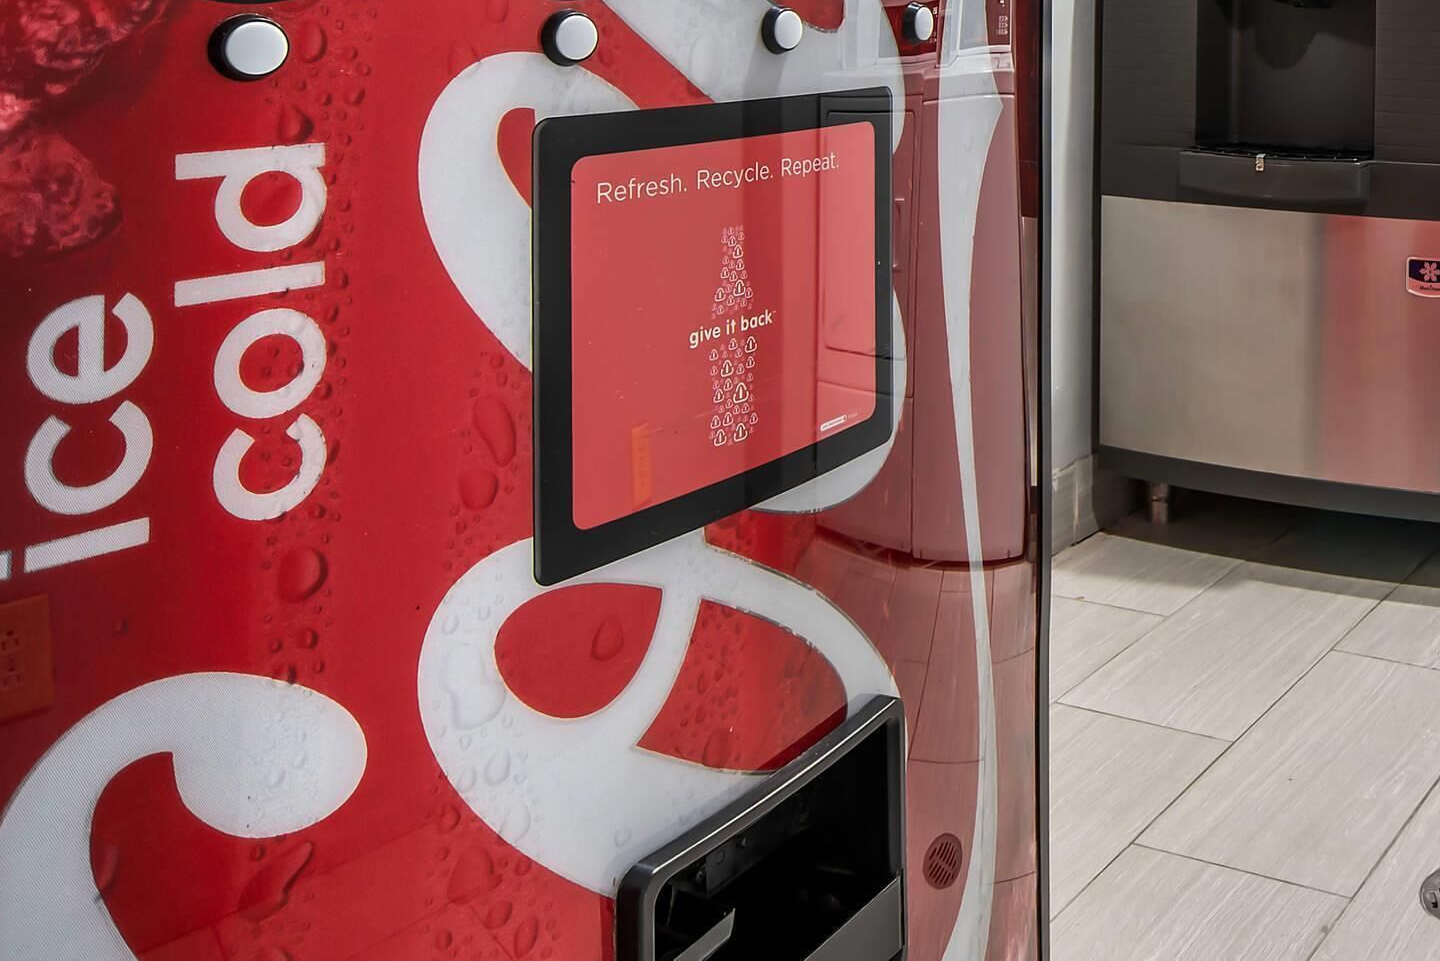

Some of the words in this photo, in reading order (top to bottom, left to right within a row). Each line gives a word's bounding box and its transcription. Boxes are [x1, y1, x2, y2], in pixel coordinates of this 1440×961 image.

[597, 173, 687, 204] Refresh.
[697, 161, 774, 191] Recycle.
[781, 151, 839, 178] Repeat.
[175, 142, 328, 521] cold
[689, 326, 721, 349] give
[726, 320, 737, 335] it
[740, 309, 773, 332] back
[0, 292, 155, 581] ice
